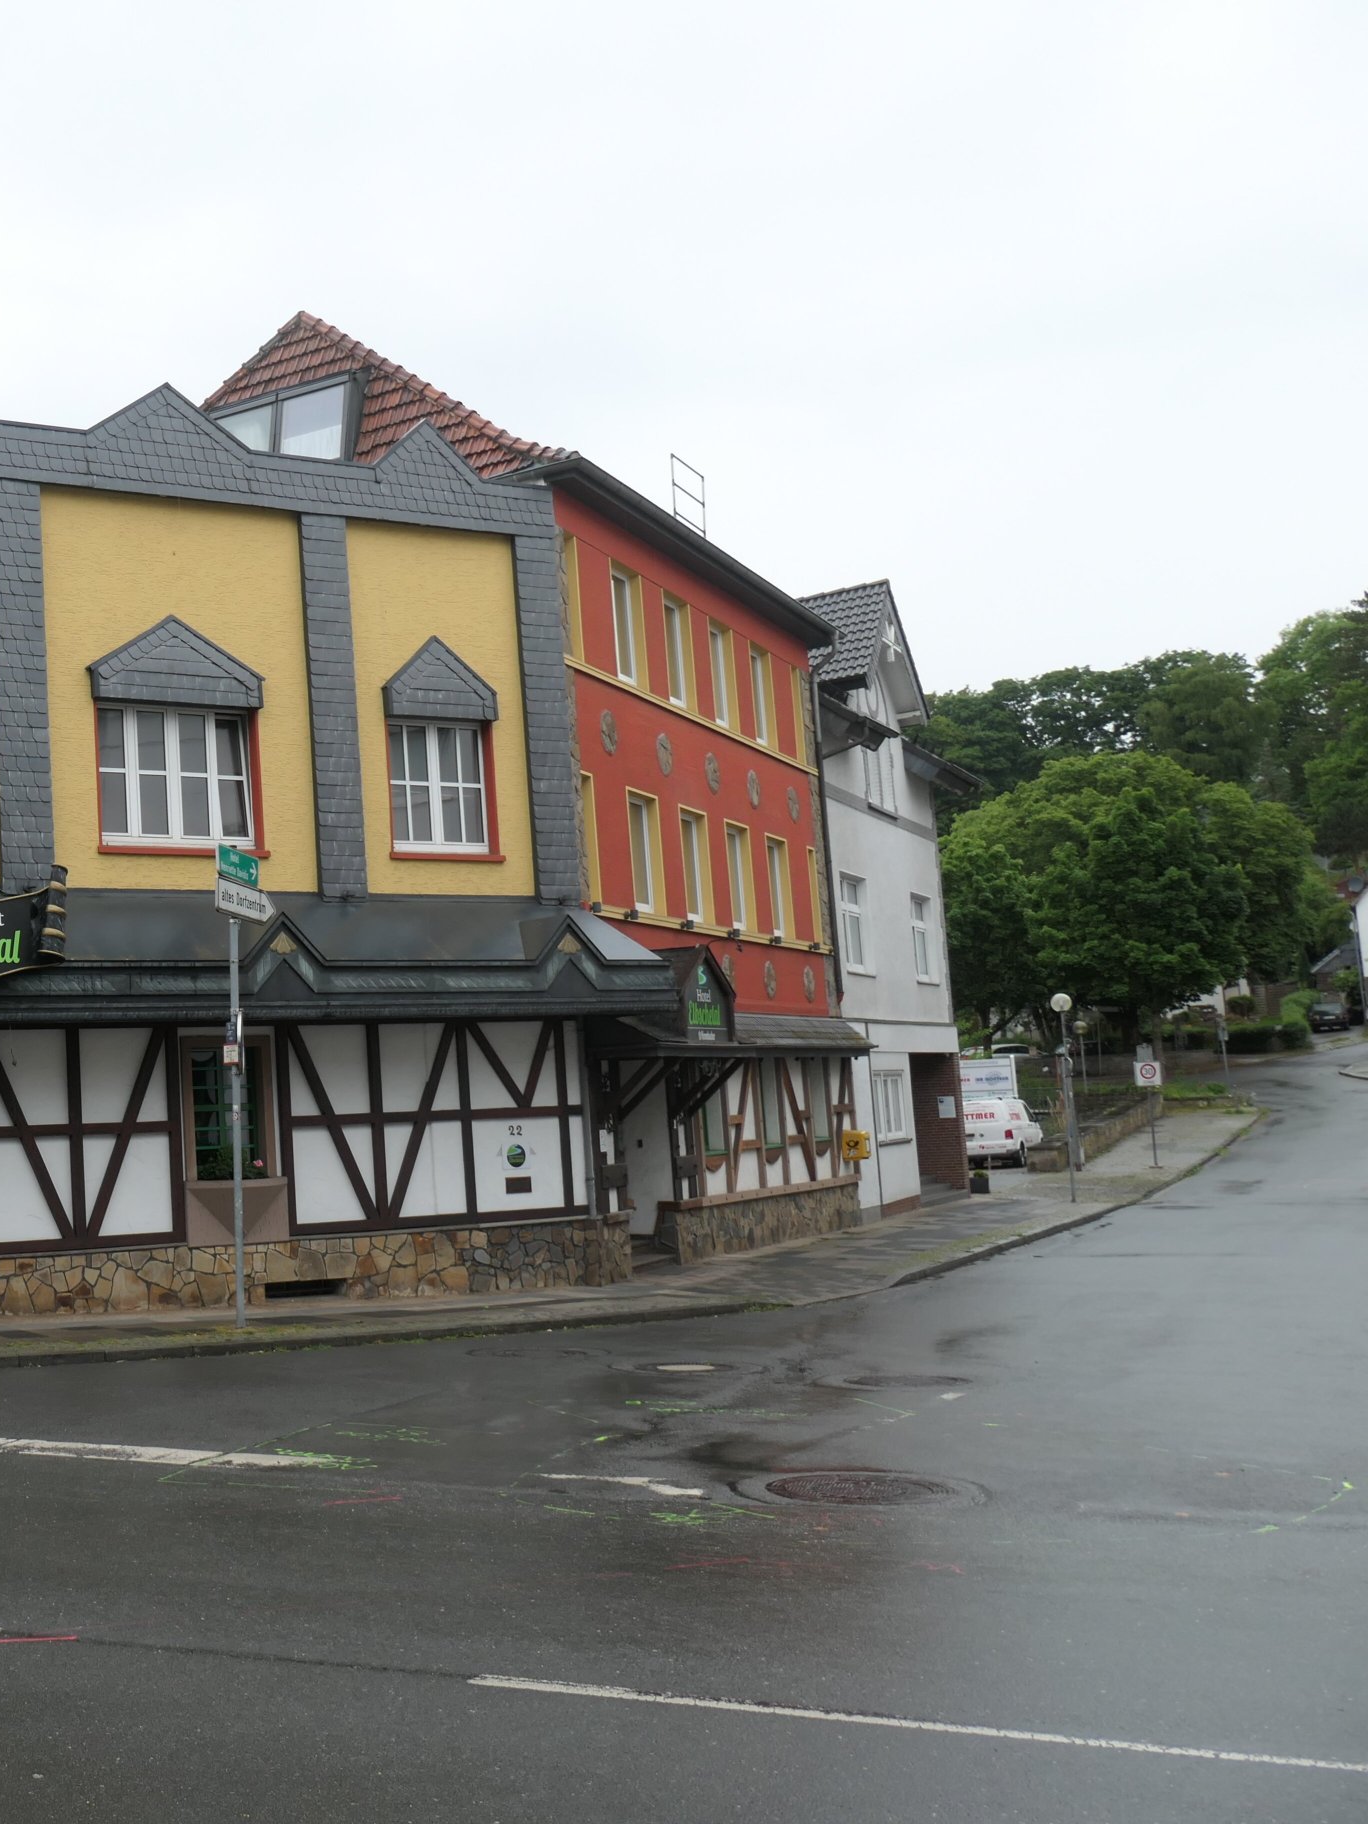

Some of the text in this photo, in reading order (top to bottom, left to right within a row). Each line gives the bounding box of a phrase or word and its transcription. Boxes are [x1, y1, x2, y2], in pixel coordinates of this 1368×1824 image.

[221, 888, 267, 914] altes Dorfzentrum
[696, 988, 712, 1002] Hotel
[688, 1000, 720, 1025] Elbschetal
[1143, 1067, 1153, 1076] 30
[508, 1125, 523, 1136] 22
